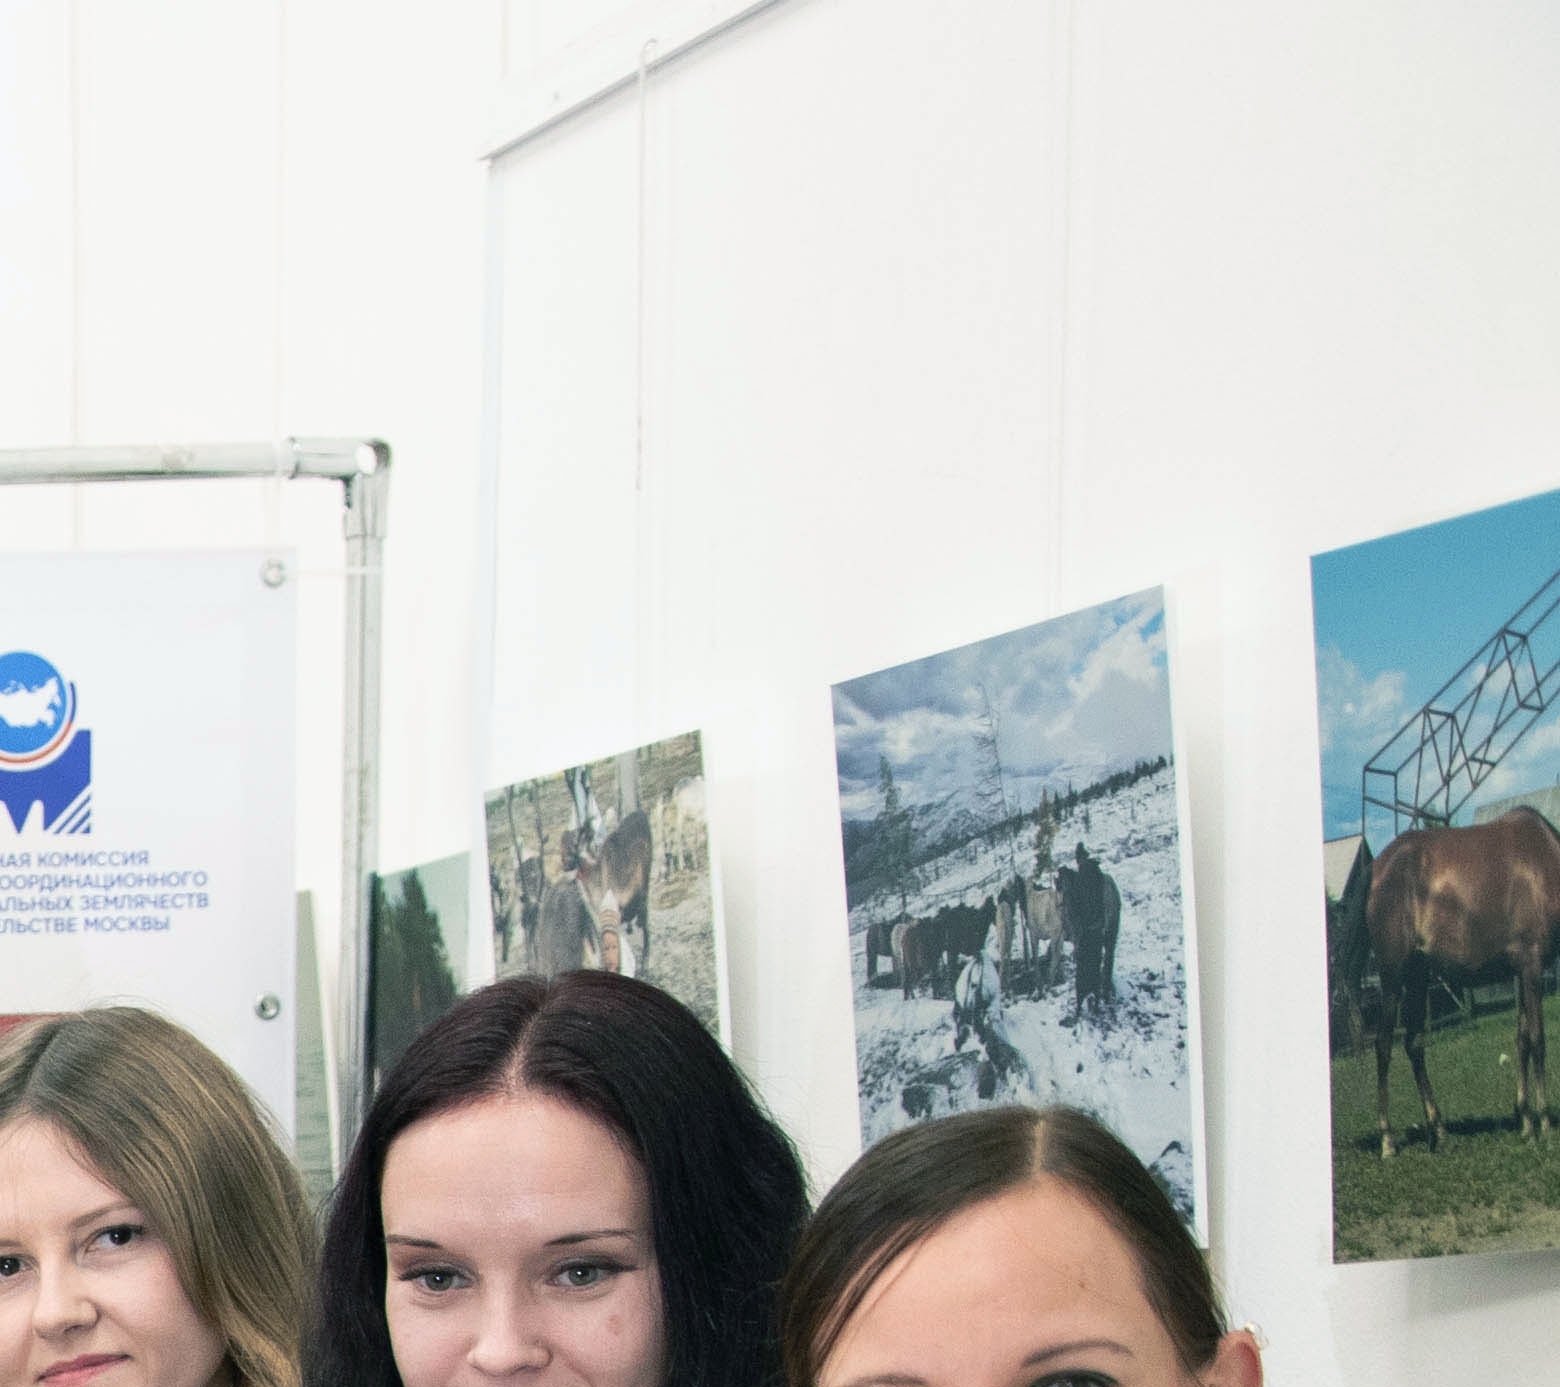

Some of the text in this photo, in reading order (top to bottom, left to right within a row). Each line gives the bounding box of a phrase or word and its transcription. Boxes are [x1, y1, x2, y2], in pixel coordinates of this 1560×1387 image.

[36, 849, 150, 869] КОМИССИЯ
[79, 891, 209, 911] ЗЕМЛЯЧЕСТВ
[83, 915, 171, 933] МОСКВЫ
